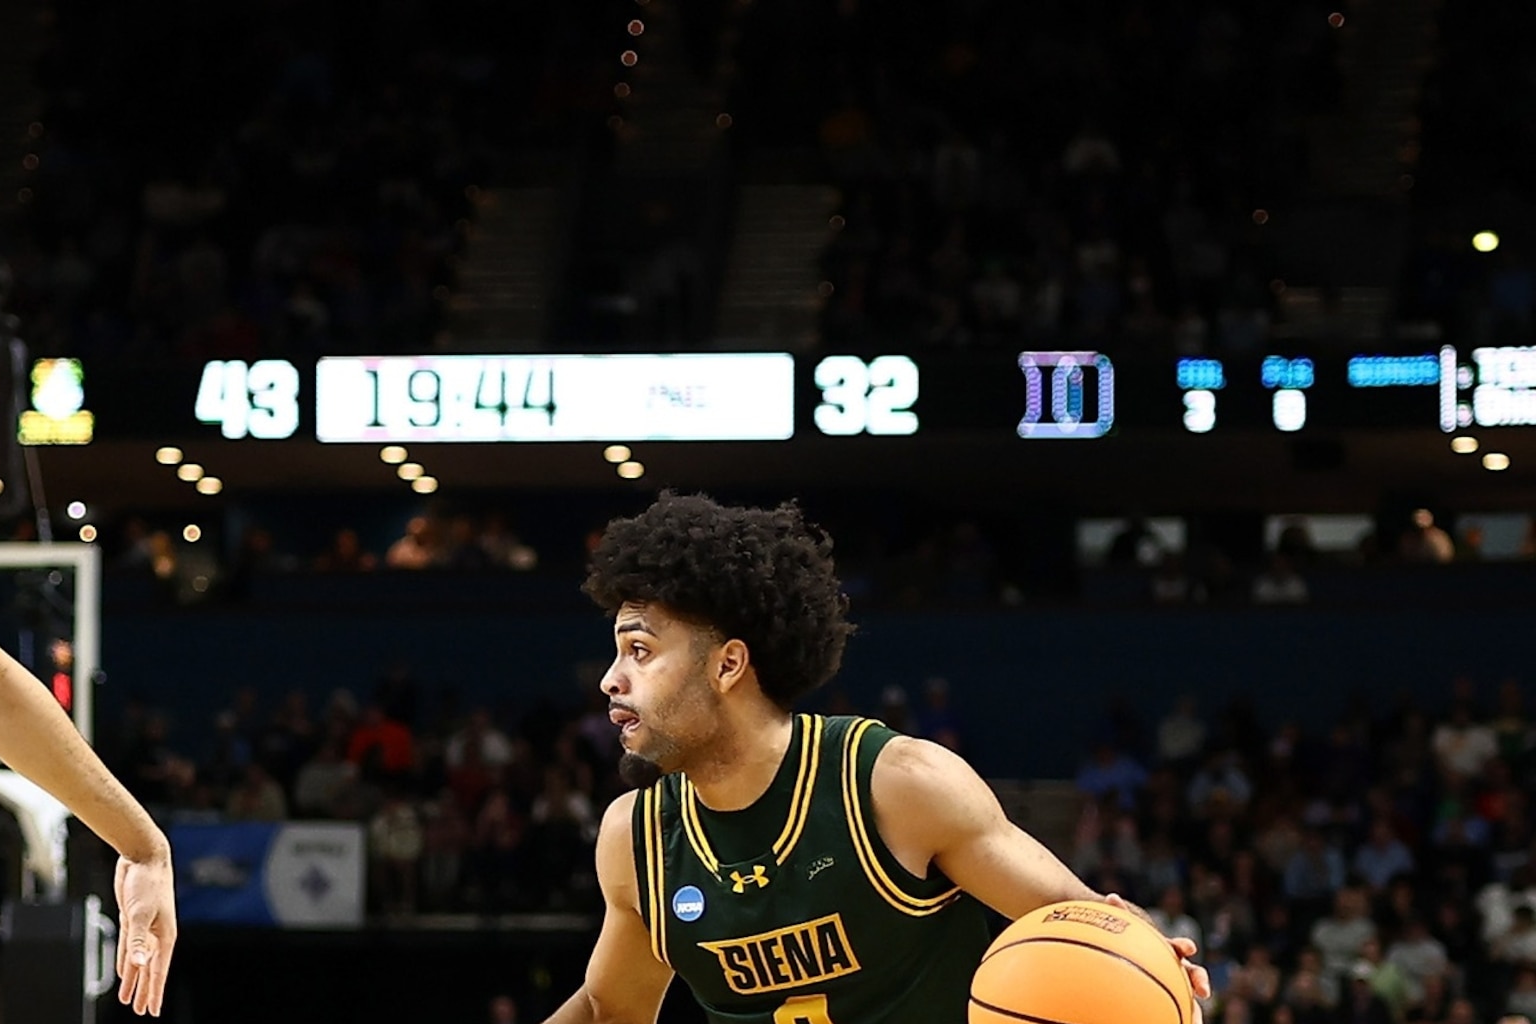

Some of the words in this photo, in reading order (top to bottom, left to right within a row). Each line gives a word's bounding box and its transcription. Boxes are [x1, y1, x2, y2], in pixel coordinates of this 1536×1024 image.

[194, 359, 300, 440] 43
[364, 366, 558, 429] 19:44
[814, 354, 920, 437] 32
[720, 921, 853, 989] SIENA
